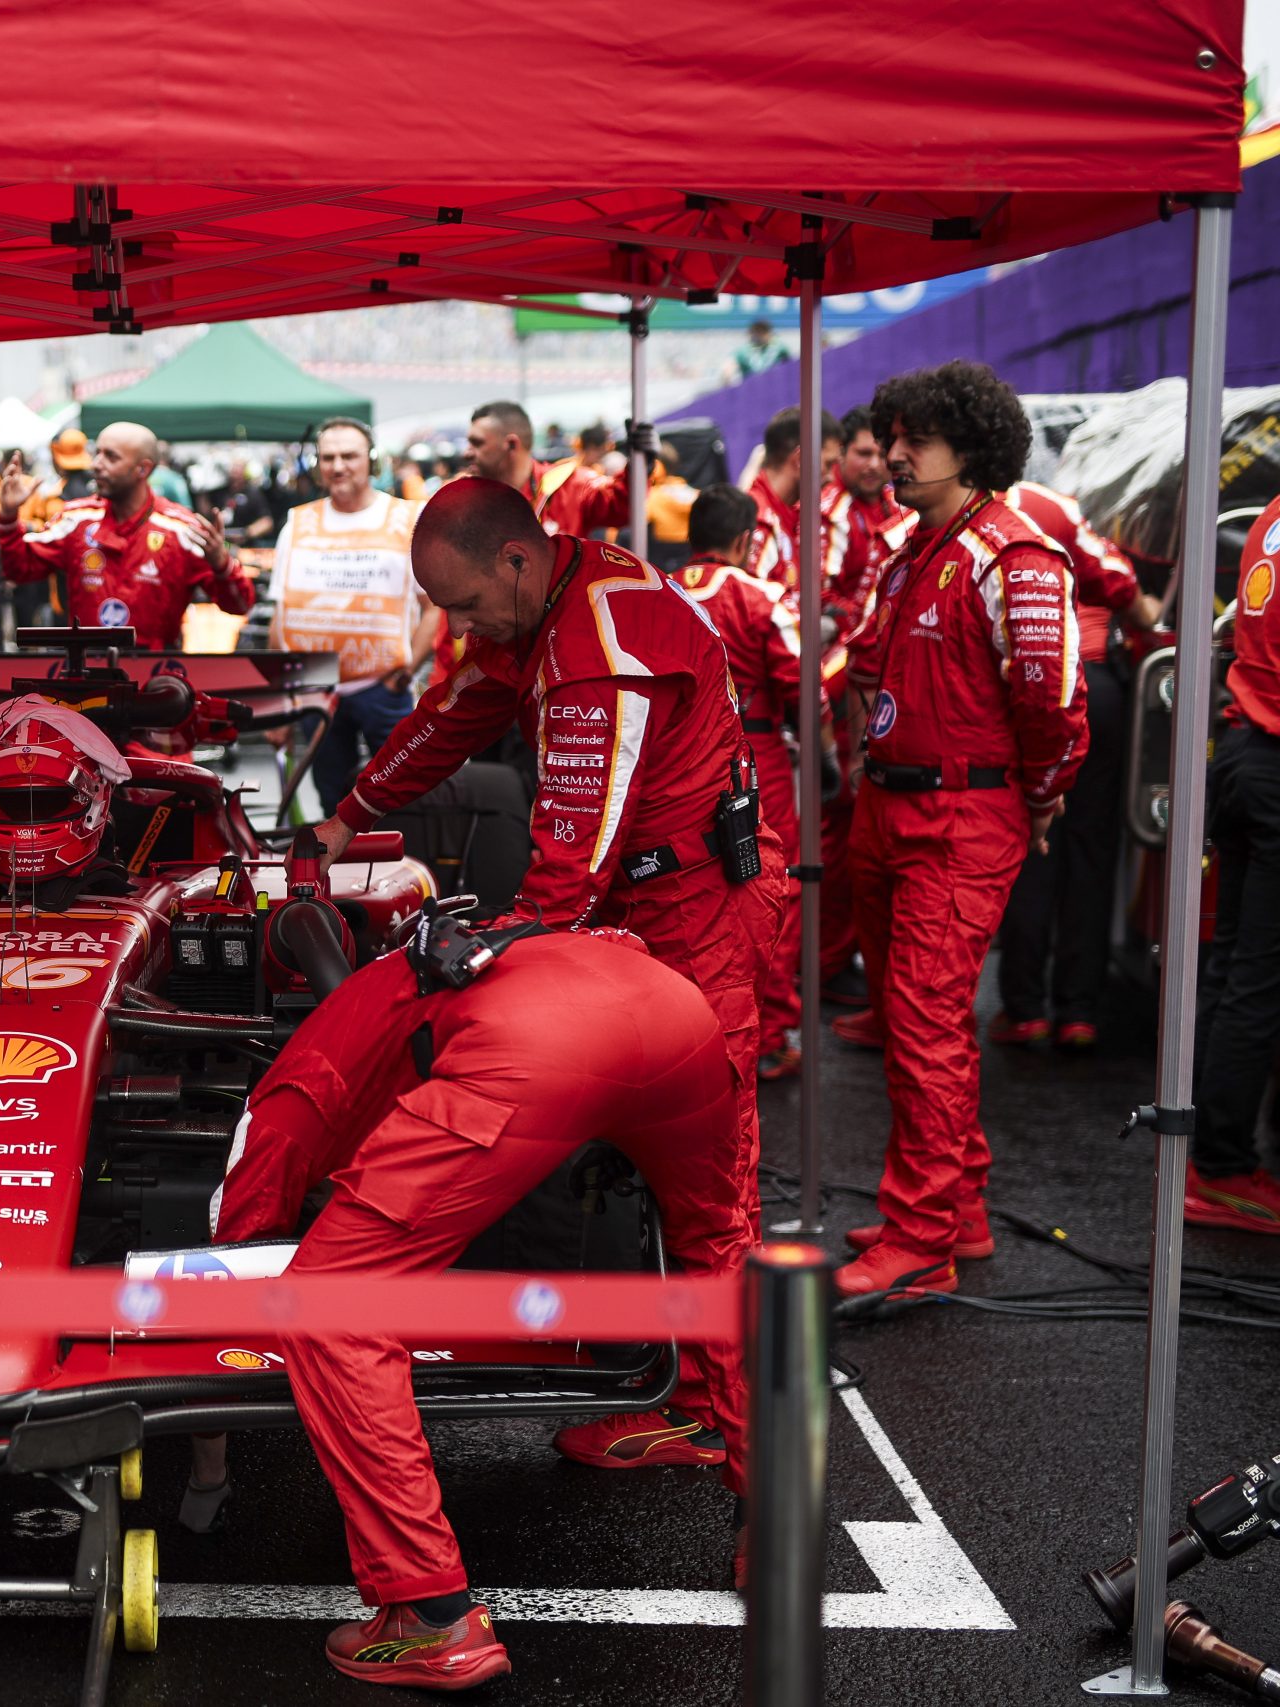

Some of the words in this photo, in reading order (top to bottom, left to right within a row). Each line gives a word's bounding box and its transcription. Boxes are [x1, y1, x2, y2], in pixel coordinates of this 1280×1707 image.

[1010, 606, 1060, 620] PIRELLI
[552, 733, 605, 745] Bitdefender
[370, 748, 410, 785] RCHARD
[406, 721, 436, 751] MILLE
[546, 751, 604, 767] PIRELLI
[543, 785, 599, 796] AUTOMOTIVE
[552, 802, 599, 813] ManpowerGroup
[630, 862, 658, 879] PUMA
[570, 894, 598, 932] MILLE
[1237, 1512, 1260, 1532] paoli
